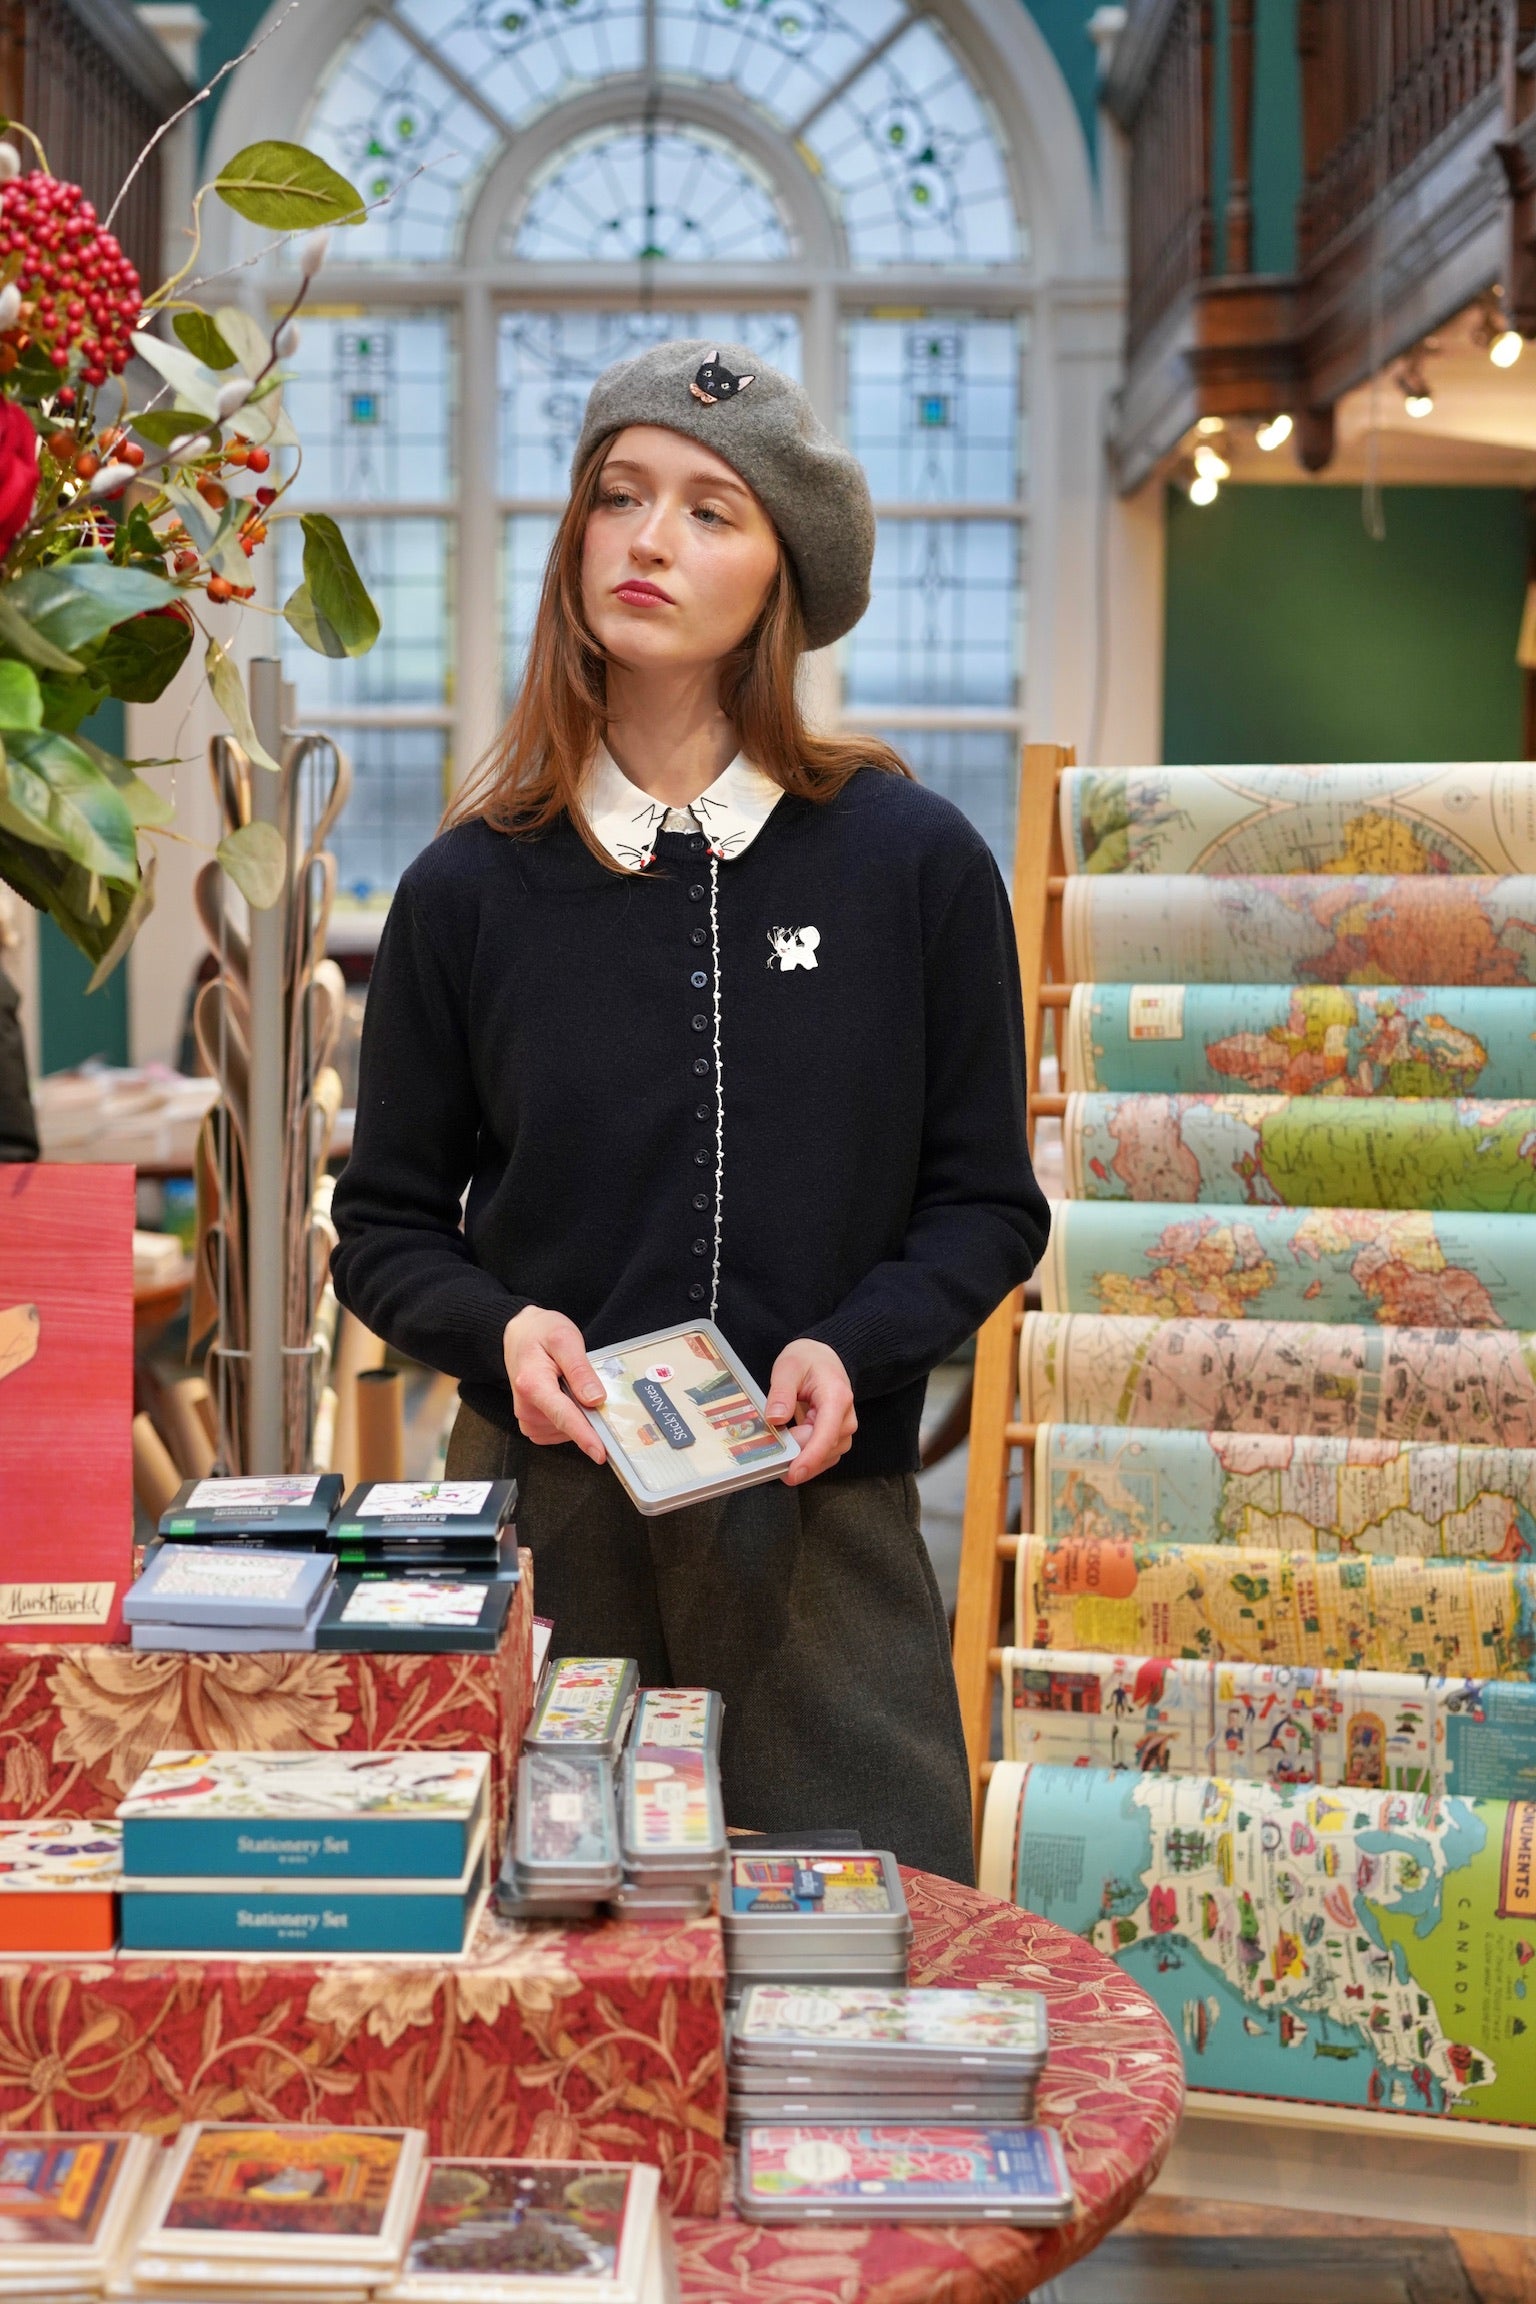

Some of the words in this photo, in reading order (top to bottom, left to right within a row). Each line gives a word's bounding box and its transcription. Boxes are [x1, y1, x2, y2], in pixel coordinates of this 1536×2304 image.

[644, 1384, 669, 1412] Notes
[662, 1412, 688, 1441] Sticky
[237, 1835, 321, 1858] Stationery
[322, 1836, 349, 1854] Set
[1515, 1801, 1536, 1899] ONUMENTS
[237, 1909, 320, 1932] Stationery
[322, 1910, 348, 1928] Set
[1454, 1898, 1471, 2015] CANADA
